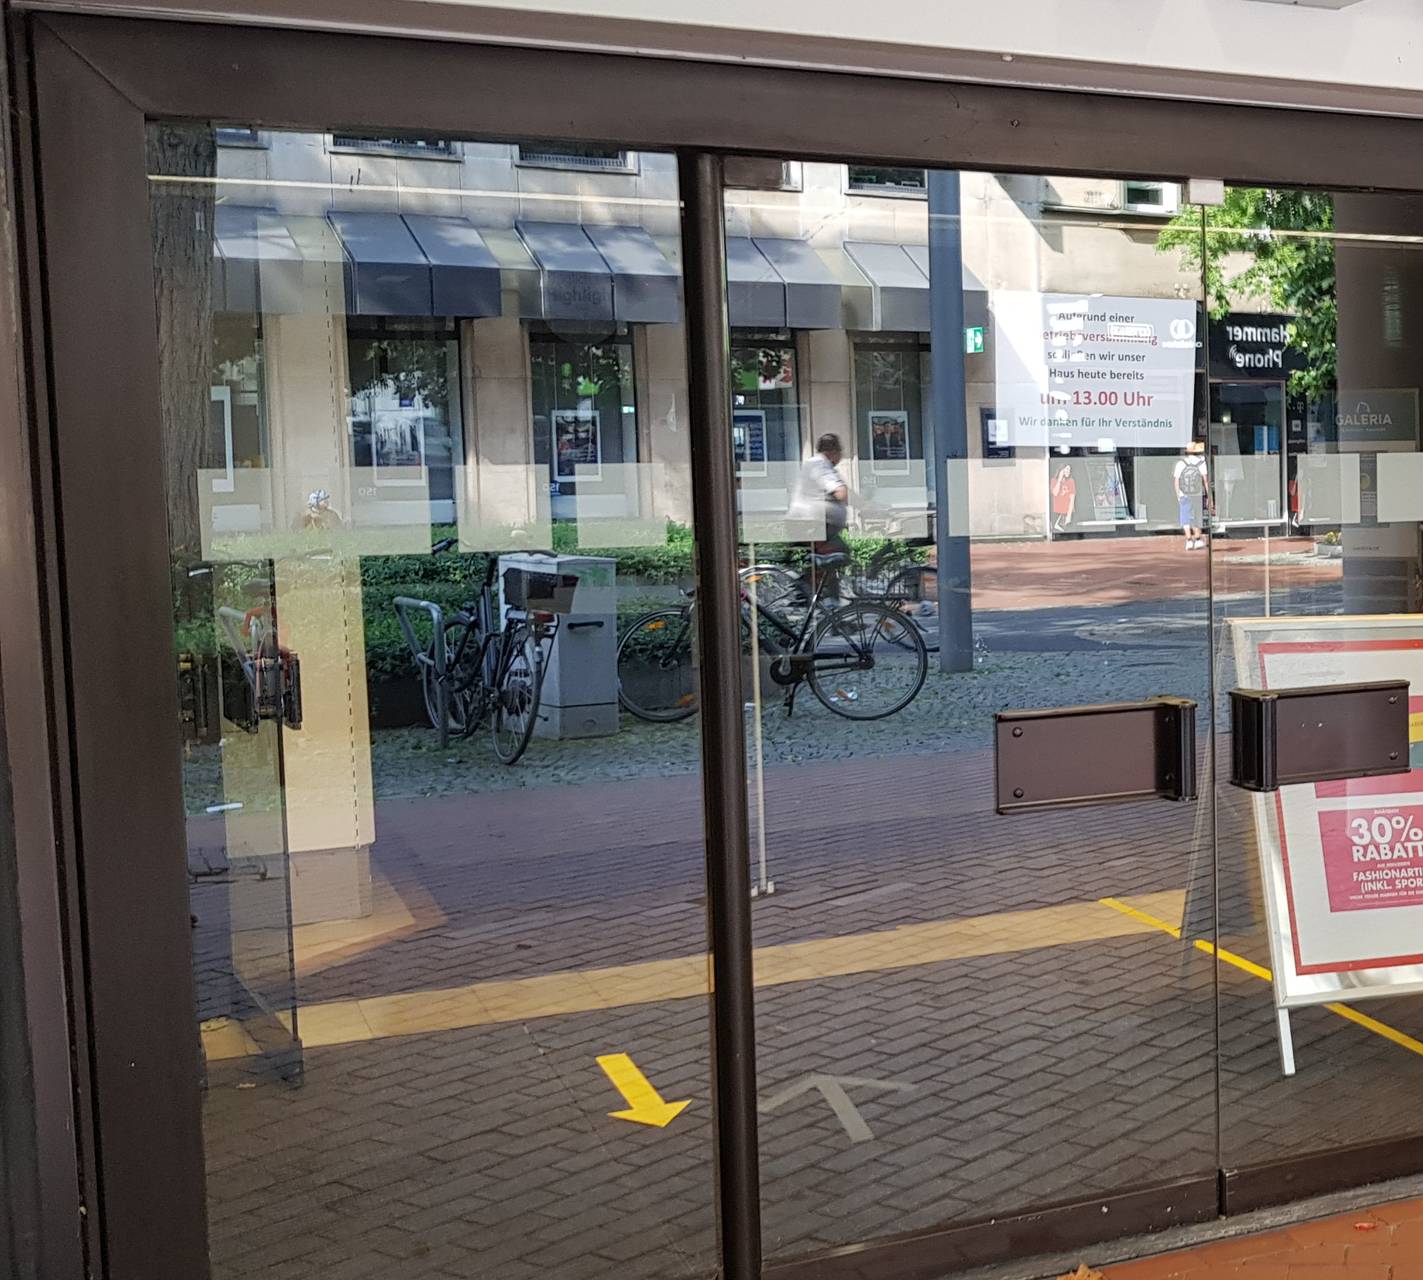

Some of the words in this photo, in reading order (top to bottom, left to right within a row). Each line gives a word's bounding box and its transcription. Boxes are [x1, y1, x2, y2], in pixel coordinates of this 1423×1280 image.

[1109, 312, 1135, 323] einer
[1099, 350, 1116, 361] wir
[1118, 353, 1146, 362] unser
[1049, 368, 1074, 379] Haus
[1077, 368, 1107, 380] heute
[1109, 369, 1145, 381] bereits
[1073, 391, 1118, 406] 13.00
[1123, 391, 1155, 407] Uhr
[1019, 416, 1038, 427] Wir
[1080, 416, 1095, 428] für
[1098, 418, 1113, 428] Ihr
[1114, 417, 1173, 429] Verständnis
[1335, 413, 1392, 427] GALERIA
[1351, 815, 1423, 846] 30%
[1361, 880, 1392, 893] (INKL.
